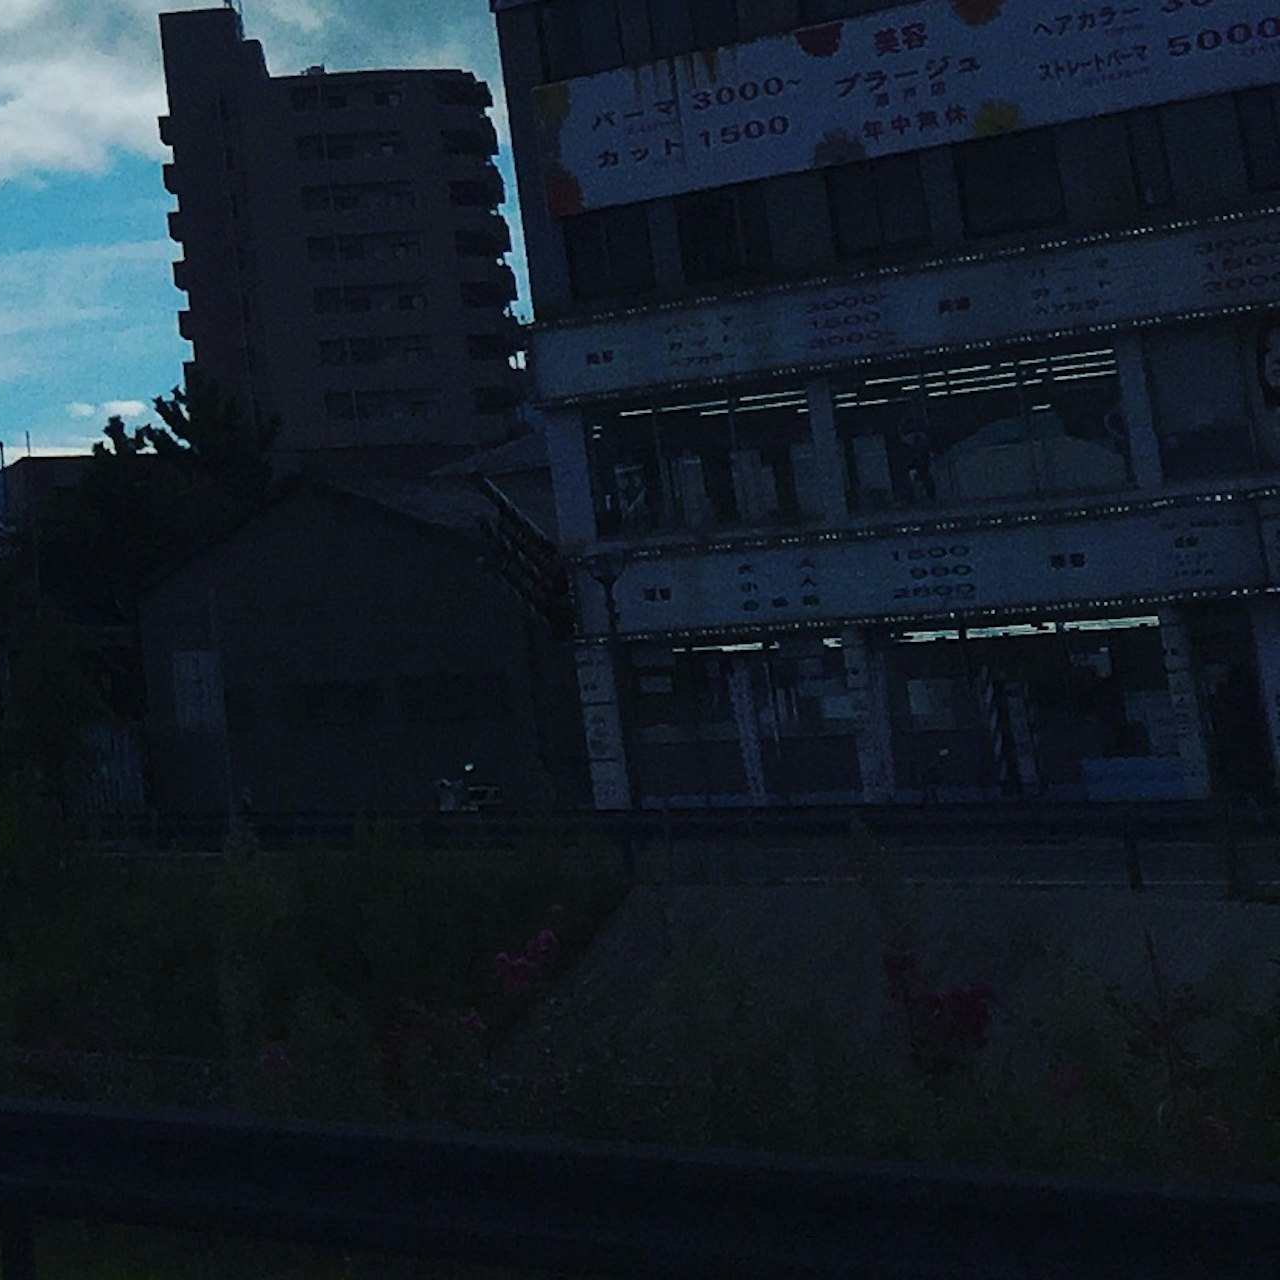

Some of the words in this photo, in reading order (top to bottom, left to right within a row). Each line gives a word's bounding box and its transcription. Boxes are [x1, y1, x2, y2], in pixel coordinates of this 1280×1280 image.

[1033, 5, 1142, 36] ヘアカラー
[873, 22, 928, 56] 美容
[1038, 44, 1148, 82] ストレートパーマ
[1167, 16, 1280, 57] 5000
[592, 96, 677, 130] パーマ
[864, 104, 968, 143] 年中無休
[598, 137, 684, 169] カット
[700, 114, 790, 149] 1500
